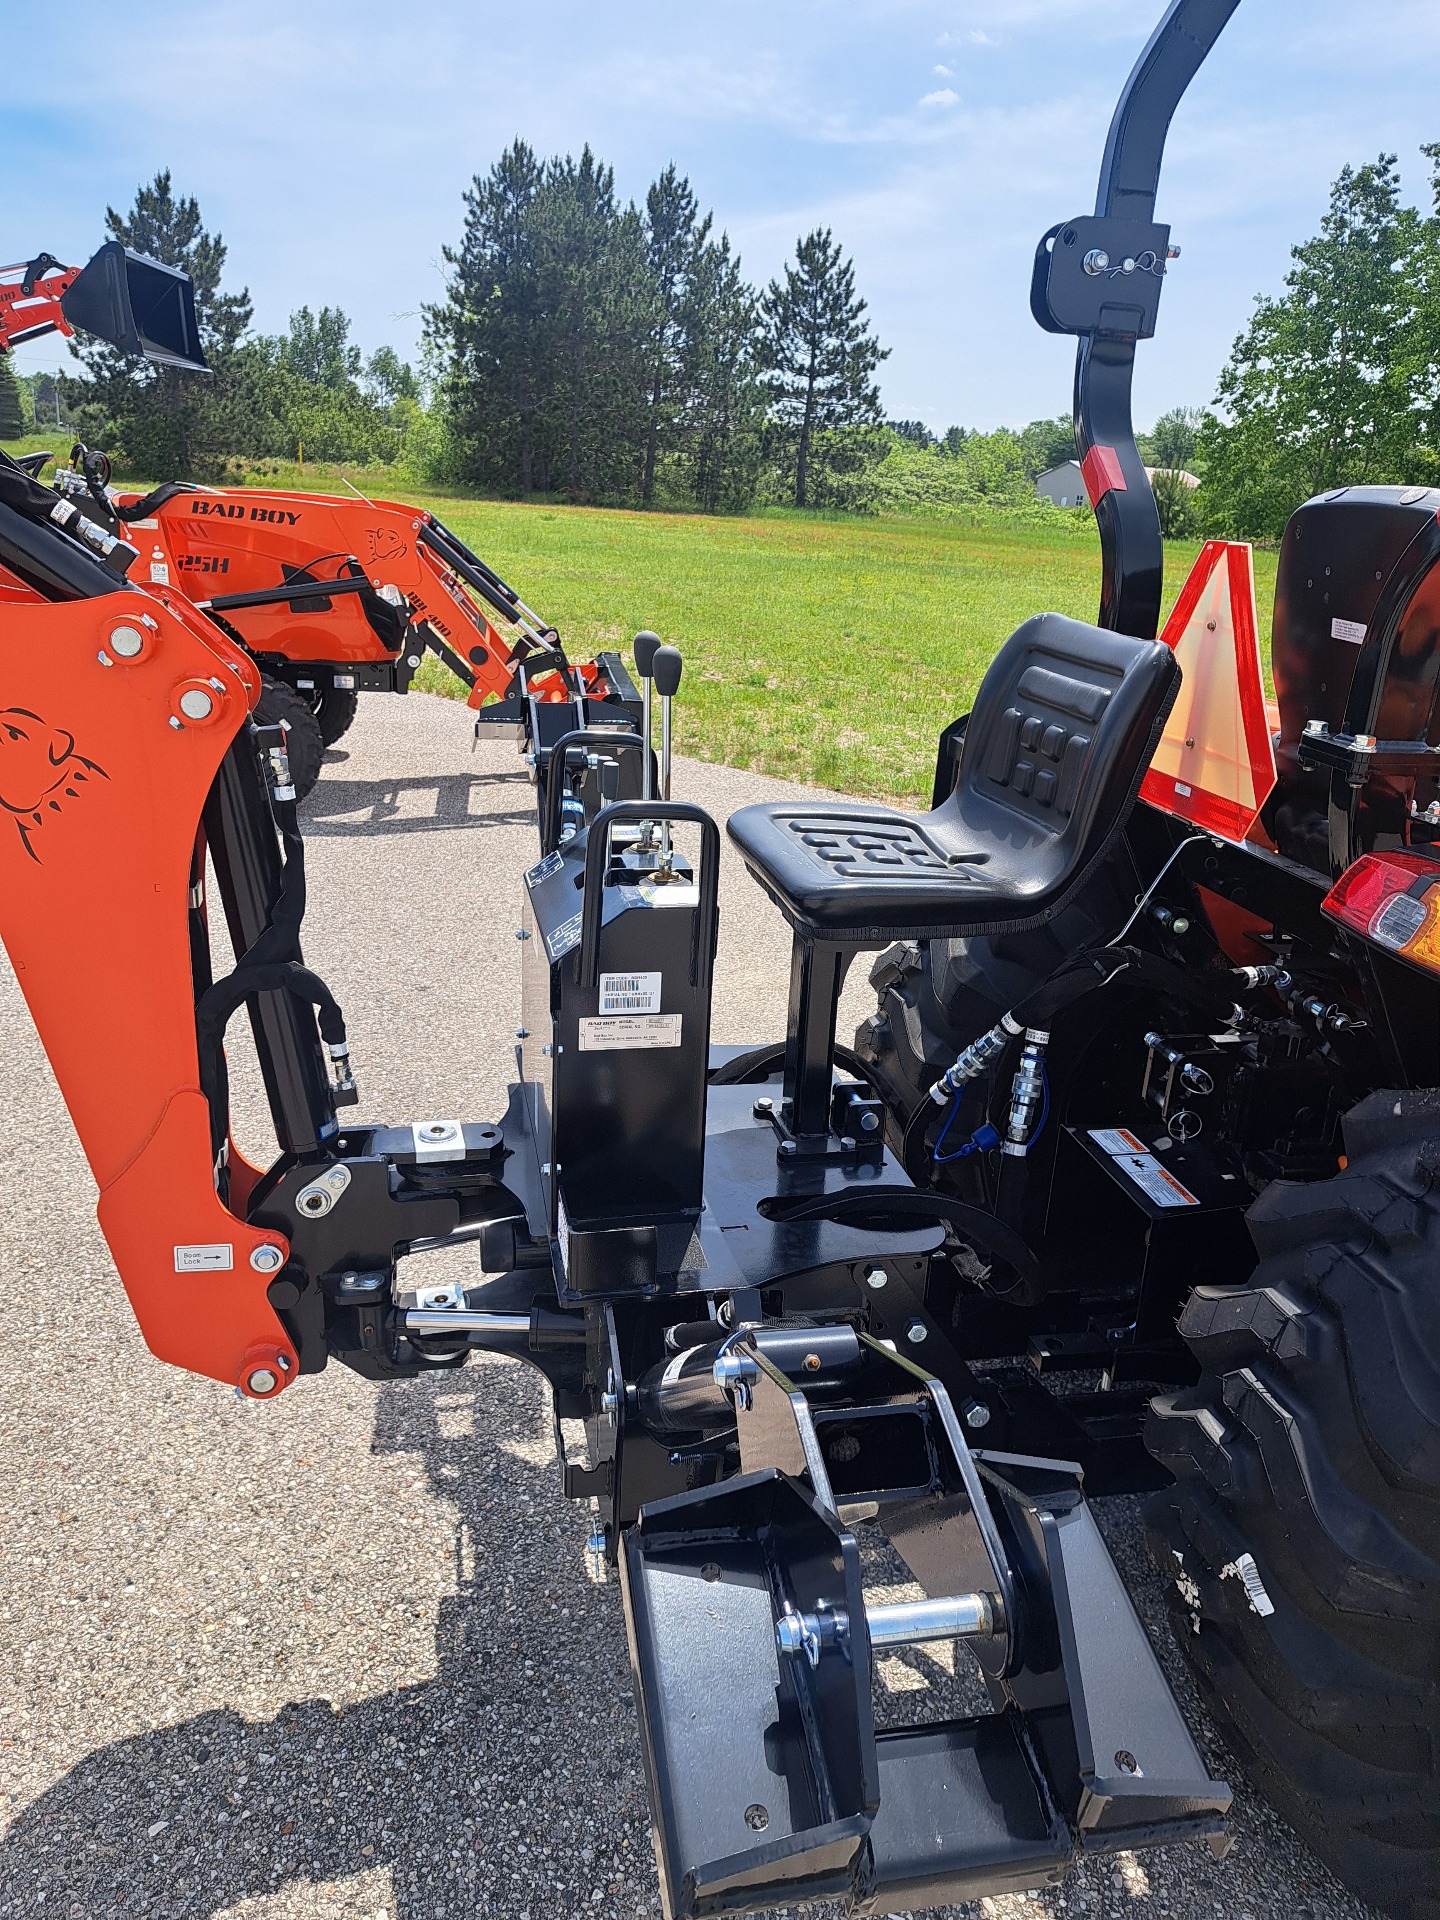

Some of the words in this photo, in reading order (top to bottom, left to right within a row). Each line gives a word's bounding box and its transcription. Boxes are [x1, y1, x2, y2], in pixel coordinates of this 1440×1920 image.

[191, 501, 245, 519] BAD
[250, 508, 302, 525] BOY
[428, 614, 452, 637] 400
